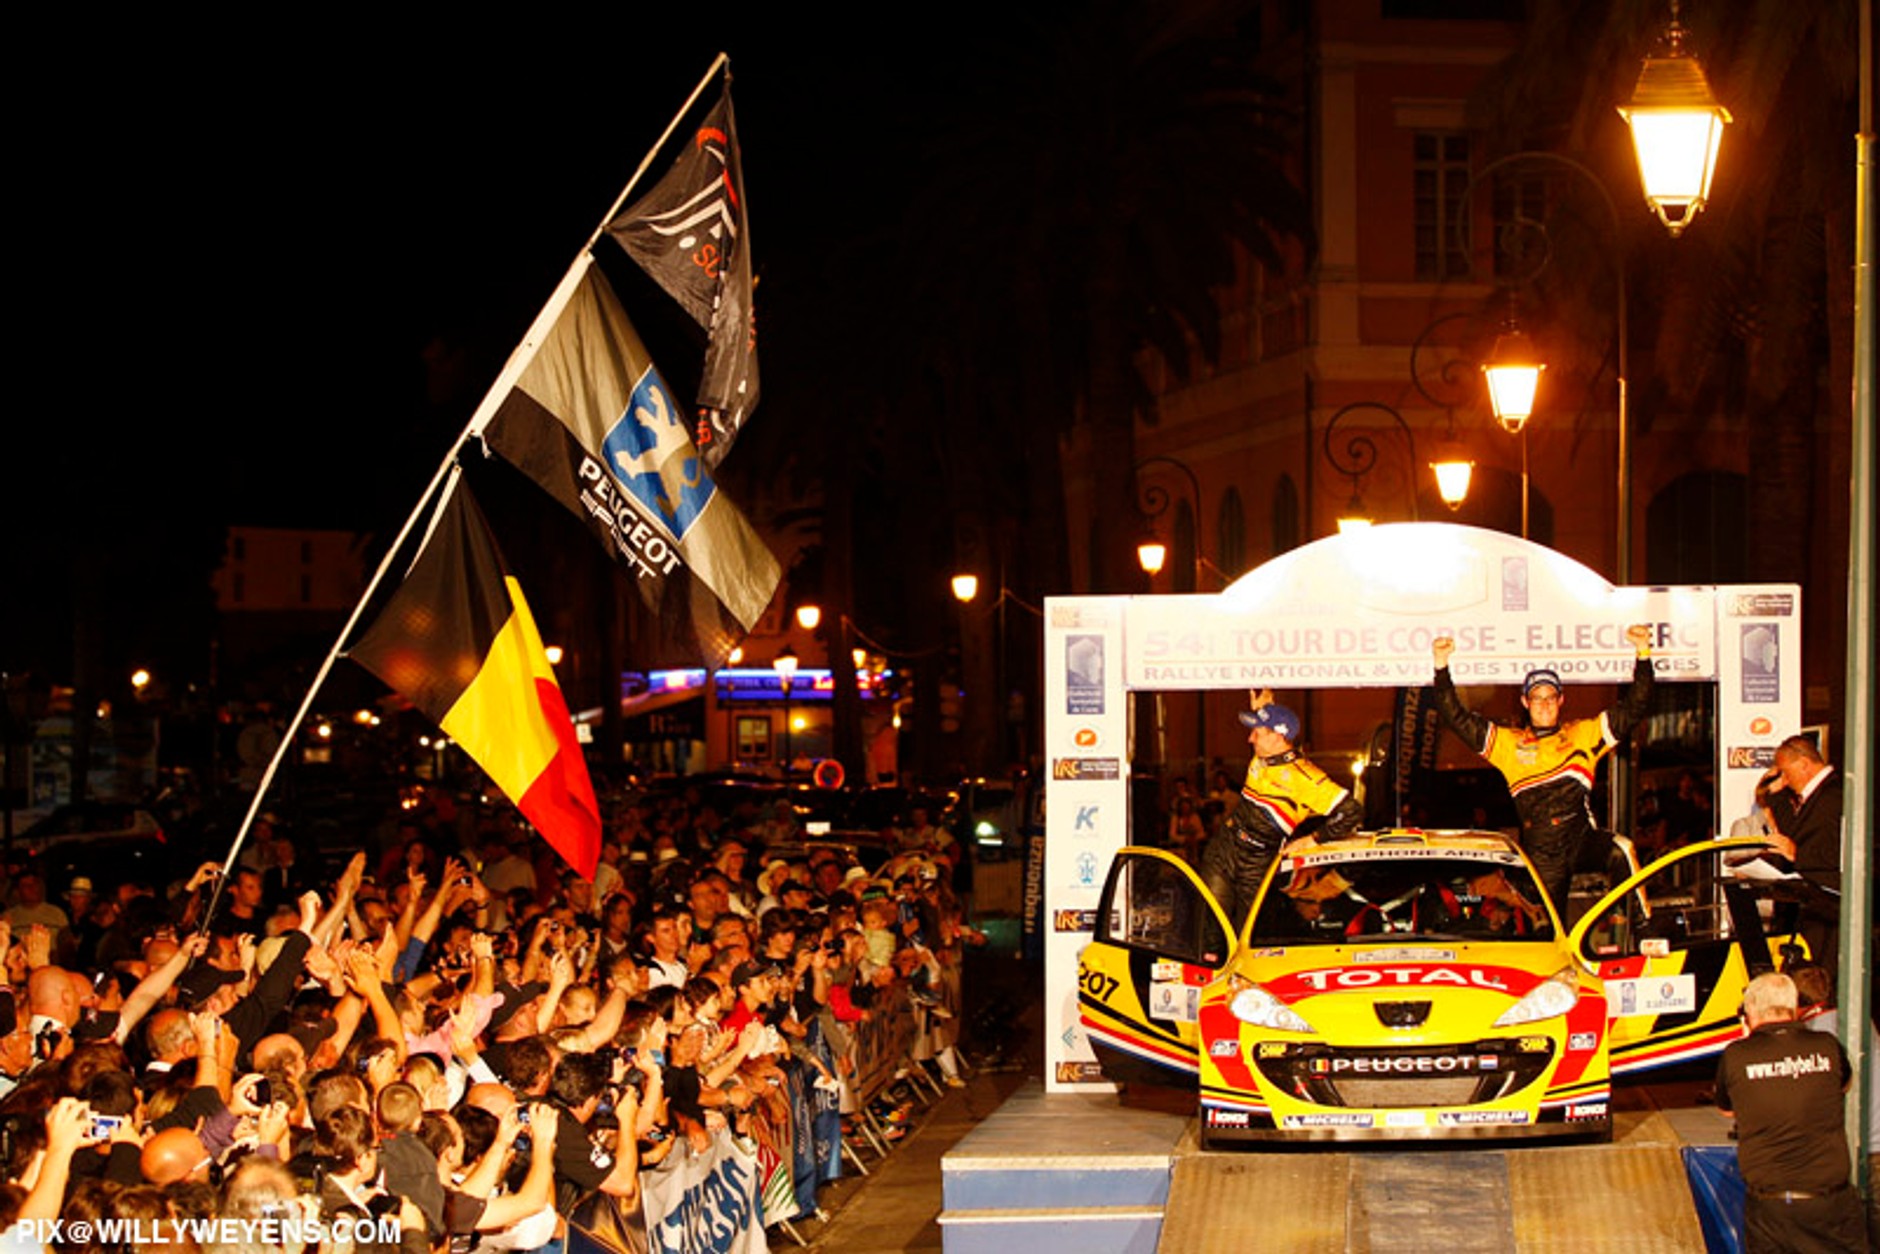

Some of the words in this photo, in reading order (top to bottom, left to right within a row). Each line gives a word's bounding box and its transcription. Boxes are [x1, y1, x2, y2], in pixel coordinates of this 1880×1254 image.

[579, 456, 681, 575] PEUGEOT
[1231, 627, 1323, 656] TOUR
[1334, 627, 1378, 654] DE
[1143, 666, 1232, 681] RALLYE
[1240, 663, 1366, 680] NATIONAL
[1372, 663, 1390, 677] &
[1595, 657, 1701, 674] VIRGES
[1078, 961, 1120, 1003] 207
[1296, 967, 1508, 990] TOTAL
[1332, 1055, 1475, 1073] PEUGEOT
[1302, 1113, 1372, 1126] MICHELIN
[1457, 1111, 1528, 1124] MICHELIN
